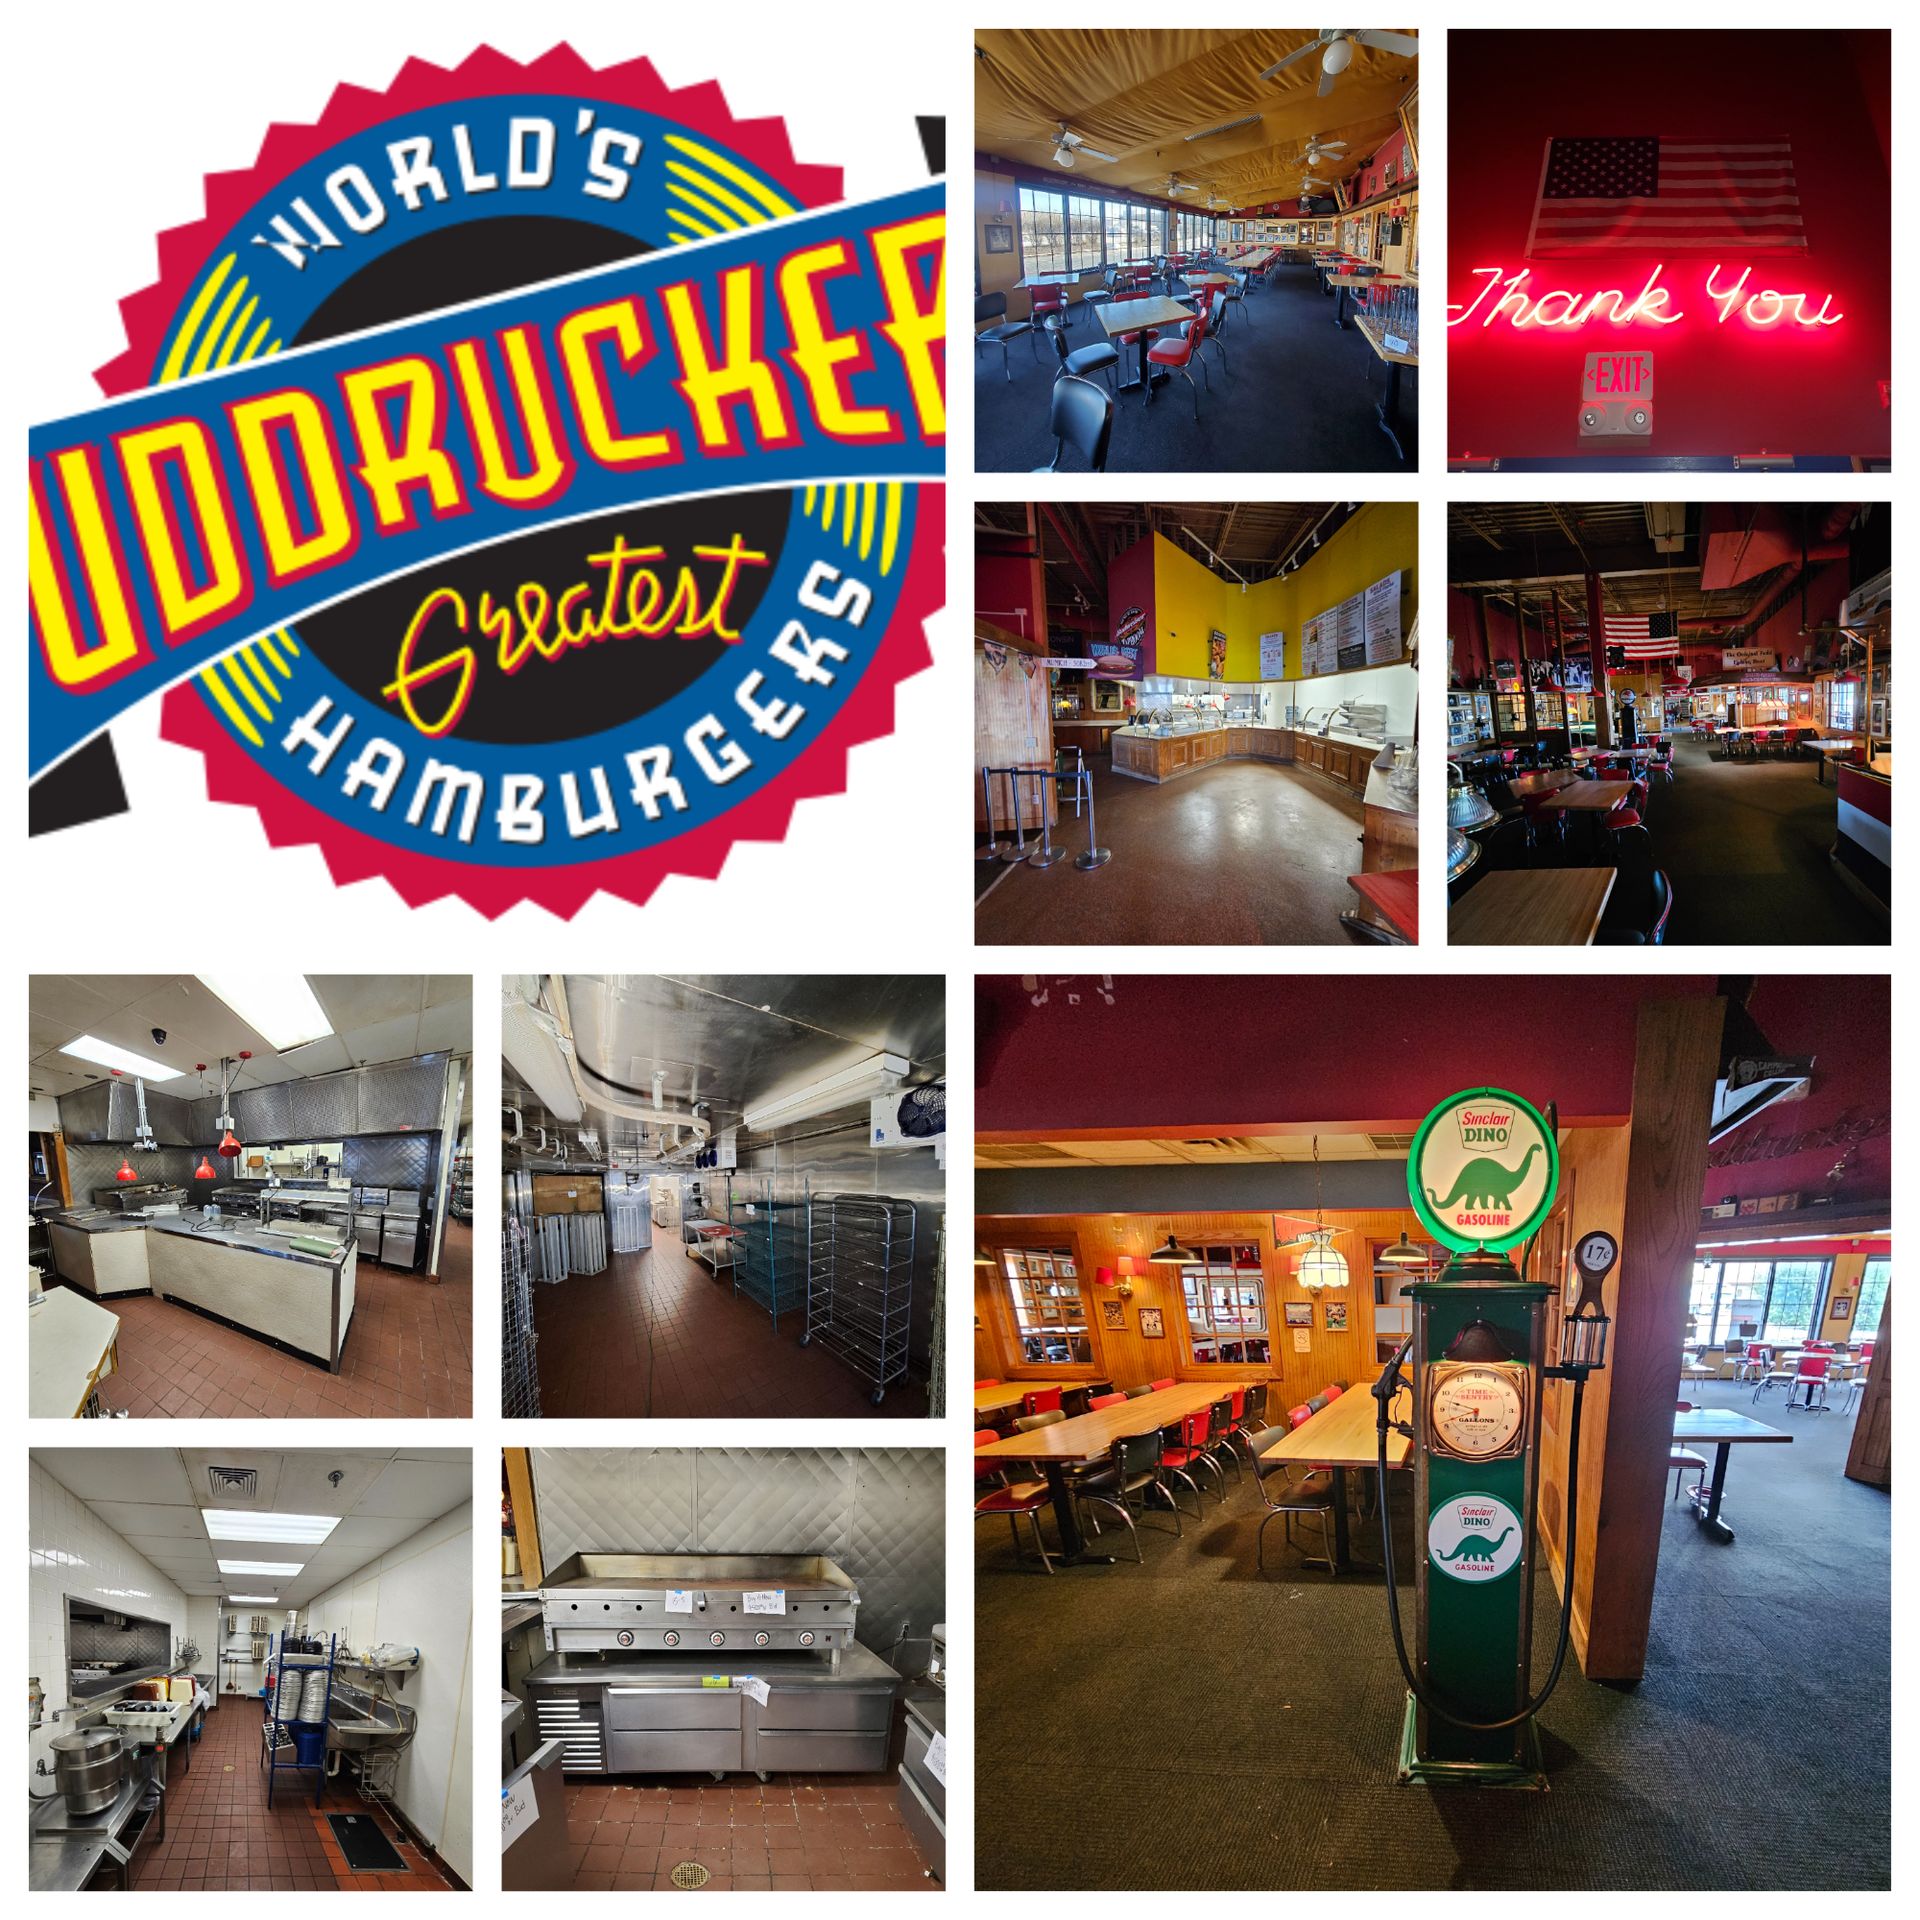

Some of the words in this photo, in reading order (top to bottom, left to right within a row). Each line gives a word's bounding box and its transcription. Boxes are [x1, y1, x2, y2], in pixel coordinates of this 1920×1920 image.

[253, 108, 642, 271] WORLD'S
[1447, 264, 1684, 328] Thank
[1705, 264, 1844, 327] You
[1595, 357, 1644, 393] EXIT
[383, 534, 766, 737] Greatest
[281, 560, 873, 844] HAMBURGERS
[1462, 1111, 1510, 1126] Sinclair
[1464, 1127, 1508, 1142] DINO
[1456, 1214, 1511, 1226] GASOLINE
[1586, 1244, 1610, 1261] 17¢
[1461, 1506, 1494, 1516] Sinclair
[1463, 1517, 1490, 1526] DINO
[1454, 1563, 1495, 1572] GASOLINE
